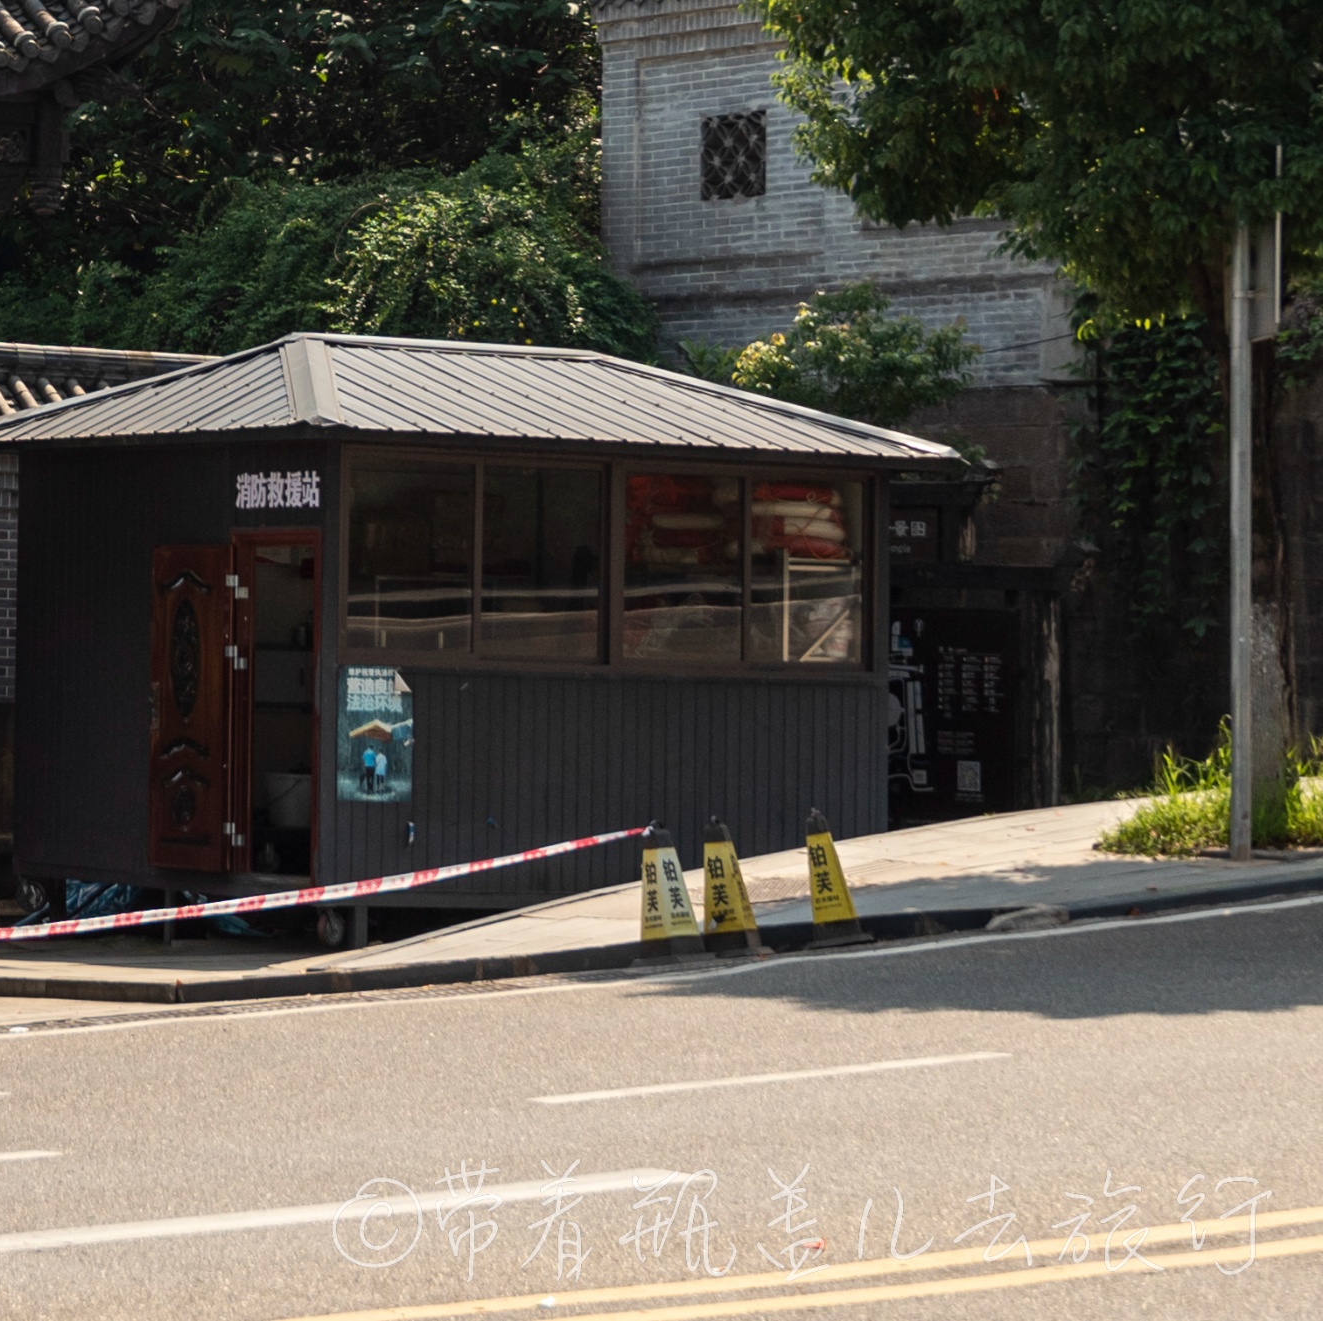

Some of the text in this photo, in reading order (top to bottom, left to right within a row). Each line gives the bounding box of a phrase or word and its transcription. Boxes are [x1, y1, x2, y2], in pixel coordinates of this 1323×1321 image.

[236, 470, 321, 509] 消防救援站
[662, 858, 684, 910] 铂芙
[707, 855, 729, 908] 铂芙
[809, 844, 833, 895] 铂芙
